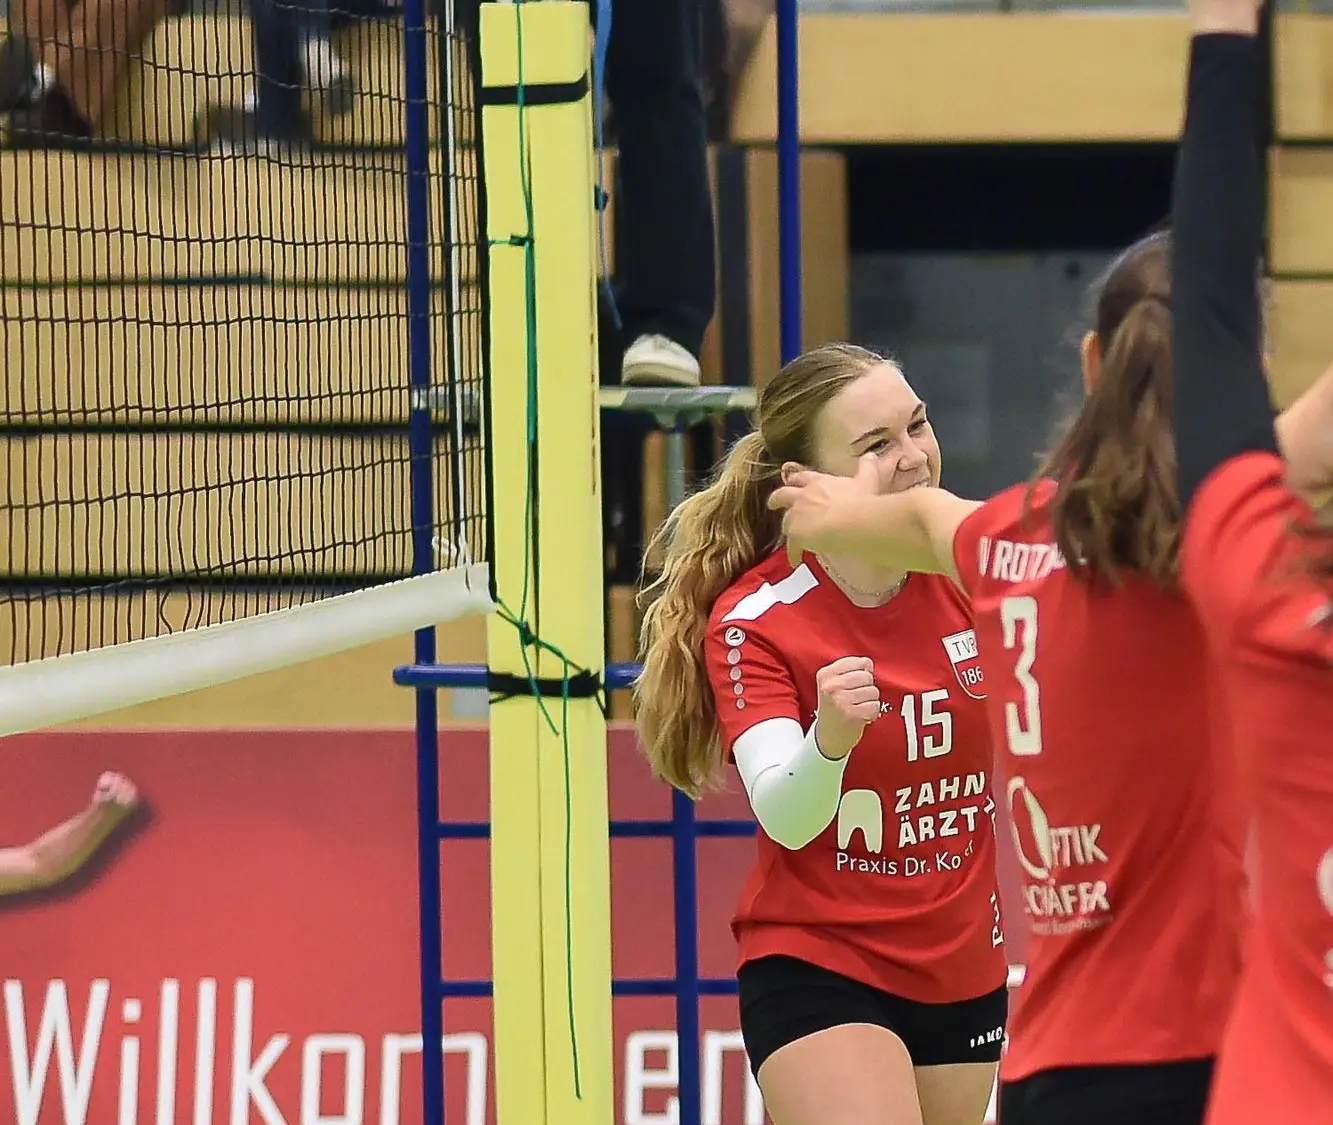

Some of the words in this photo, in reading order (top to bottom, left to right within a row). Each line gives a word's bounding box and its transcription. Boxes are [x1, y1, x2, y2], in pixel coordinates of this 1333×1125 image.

[1001, 595, 1043, 757] 3
[900, 689, 952, 762] 15
[895, 771, 986, 814] ZAHN
[836, 852, 898, 876] Praxis
[905, 856, 931, 877] Dr.
